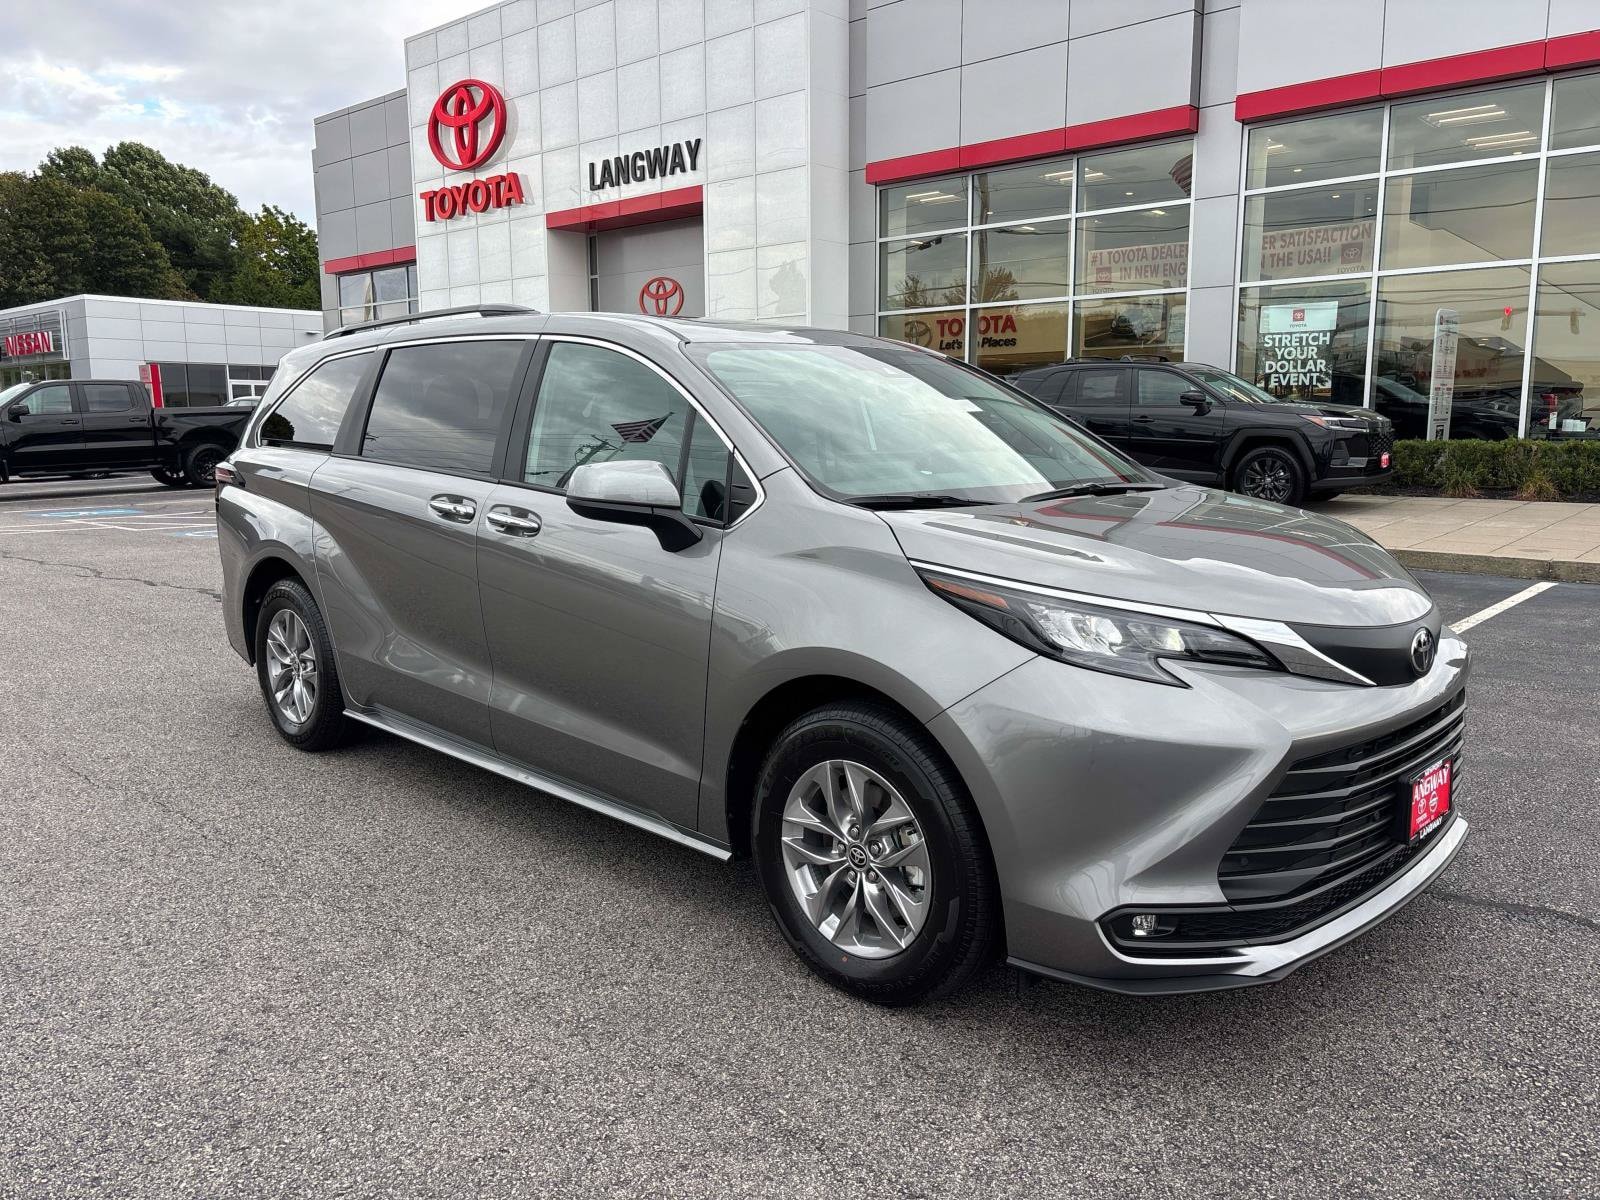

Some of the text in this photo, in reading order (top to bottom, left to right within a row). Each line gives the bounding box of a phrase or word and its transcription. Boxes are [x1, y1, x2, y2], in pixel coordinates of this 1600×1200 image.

[589, 138, 702, 191] LANGWAY
[420, 172, 524, 222] TOYOTA
[1280, 223, 1373, 249] SATISFACTION
[1090, 251, 1103, 266] #1
[1107, 247, 1148, 265] TOYOTA
[1270, 252, 1293, 269] THE
[1297, 246, 1332, 266] USA!!
[1120, 266, 1132, 280] IN
[1134, 264, 1160, 279] NEW
[1337, 265, 1366, 274] TOYOTA
[937, 314, 1017, 337] TOOTA
[5, 331, 52, 357] NISSAN
[939, 336, 1017, 351] Let's Places
[1264, 332, 1330, 348] STRETCH
[1275, 346, 1318, 360] YOUR
[1265, 360, 1327, 374] DOLLAR
[1270, 373, 1320, 386] EVENT
